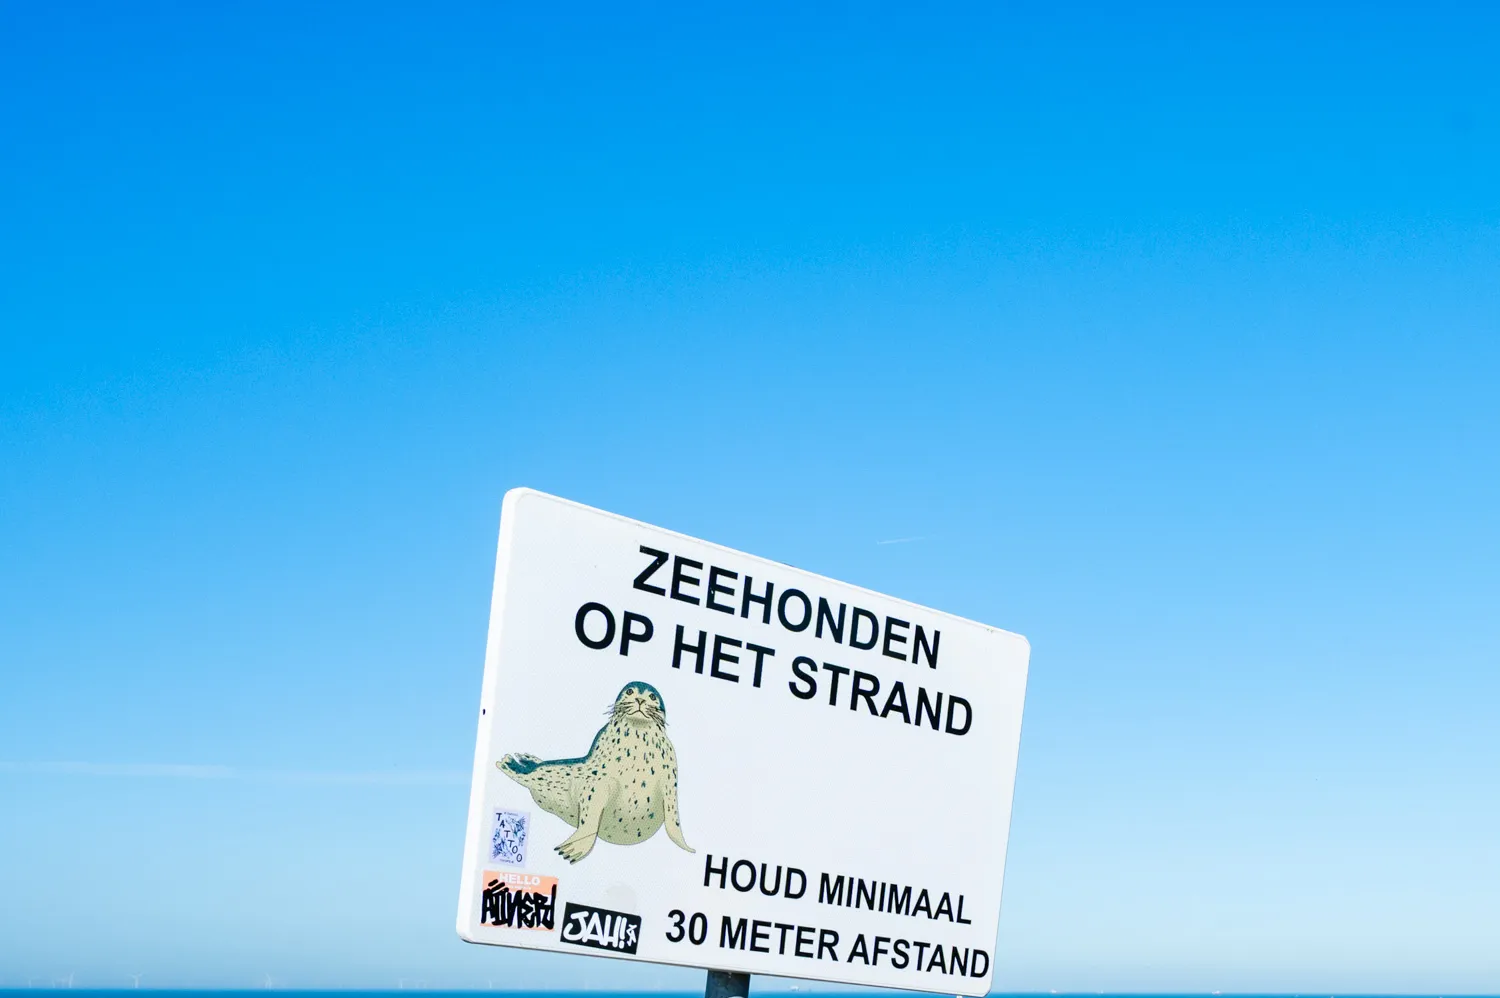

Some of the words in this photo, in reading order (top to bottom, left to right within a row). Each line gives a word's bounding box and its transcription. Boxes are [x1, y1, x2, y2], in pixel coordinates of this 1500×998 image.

[633, 545, 941, 669] ZEEHONDEN
[575, 602, 654, 656] OP
[672, 625, 776, 688] HET
[788, 656, 973, 736] STRAND
[495, 812, 523, 863] TATTOO
[499, 872, 541, 886] HELLO
[704, 854, 807, 899] HOUD
[819, 873, 972, 924] MINIMAAL
[665, 910, 708, 945] 30
[719, 916, 840, 961] METER
[847, 934, 990, 978] AFSTAND
